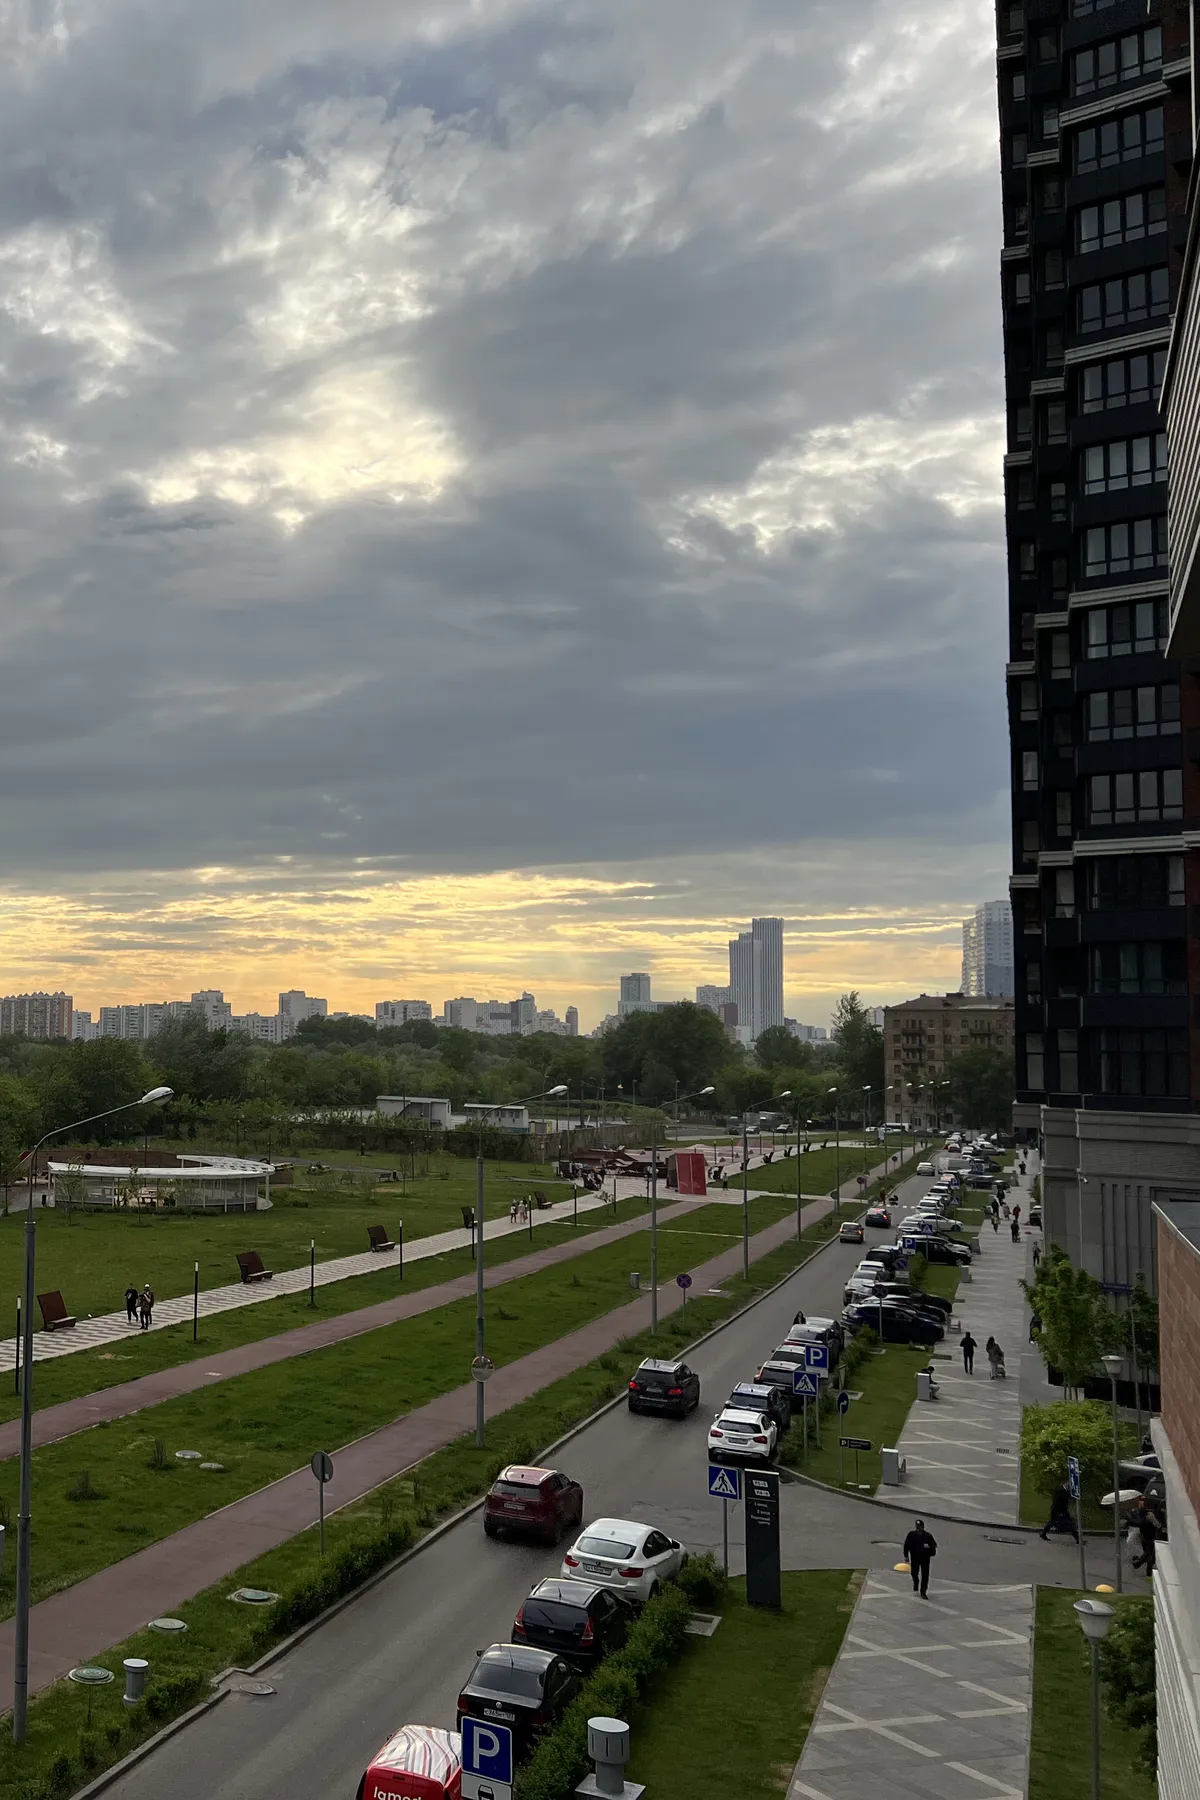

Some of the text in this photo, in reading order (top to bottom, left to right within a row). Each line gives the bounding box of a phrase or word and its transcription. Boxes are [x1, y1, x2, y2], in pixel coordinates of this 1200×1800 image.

[904, 1238, 913, 1248] P
[810, 1347, 823, 1365] P
[473, 1725, 500, 1769] P
